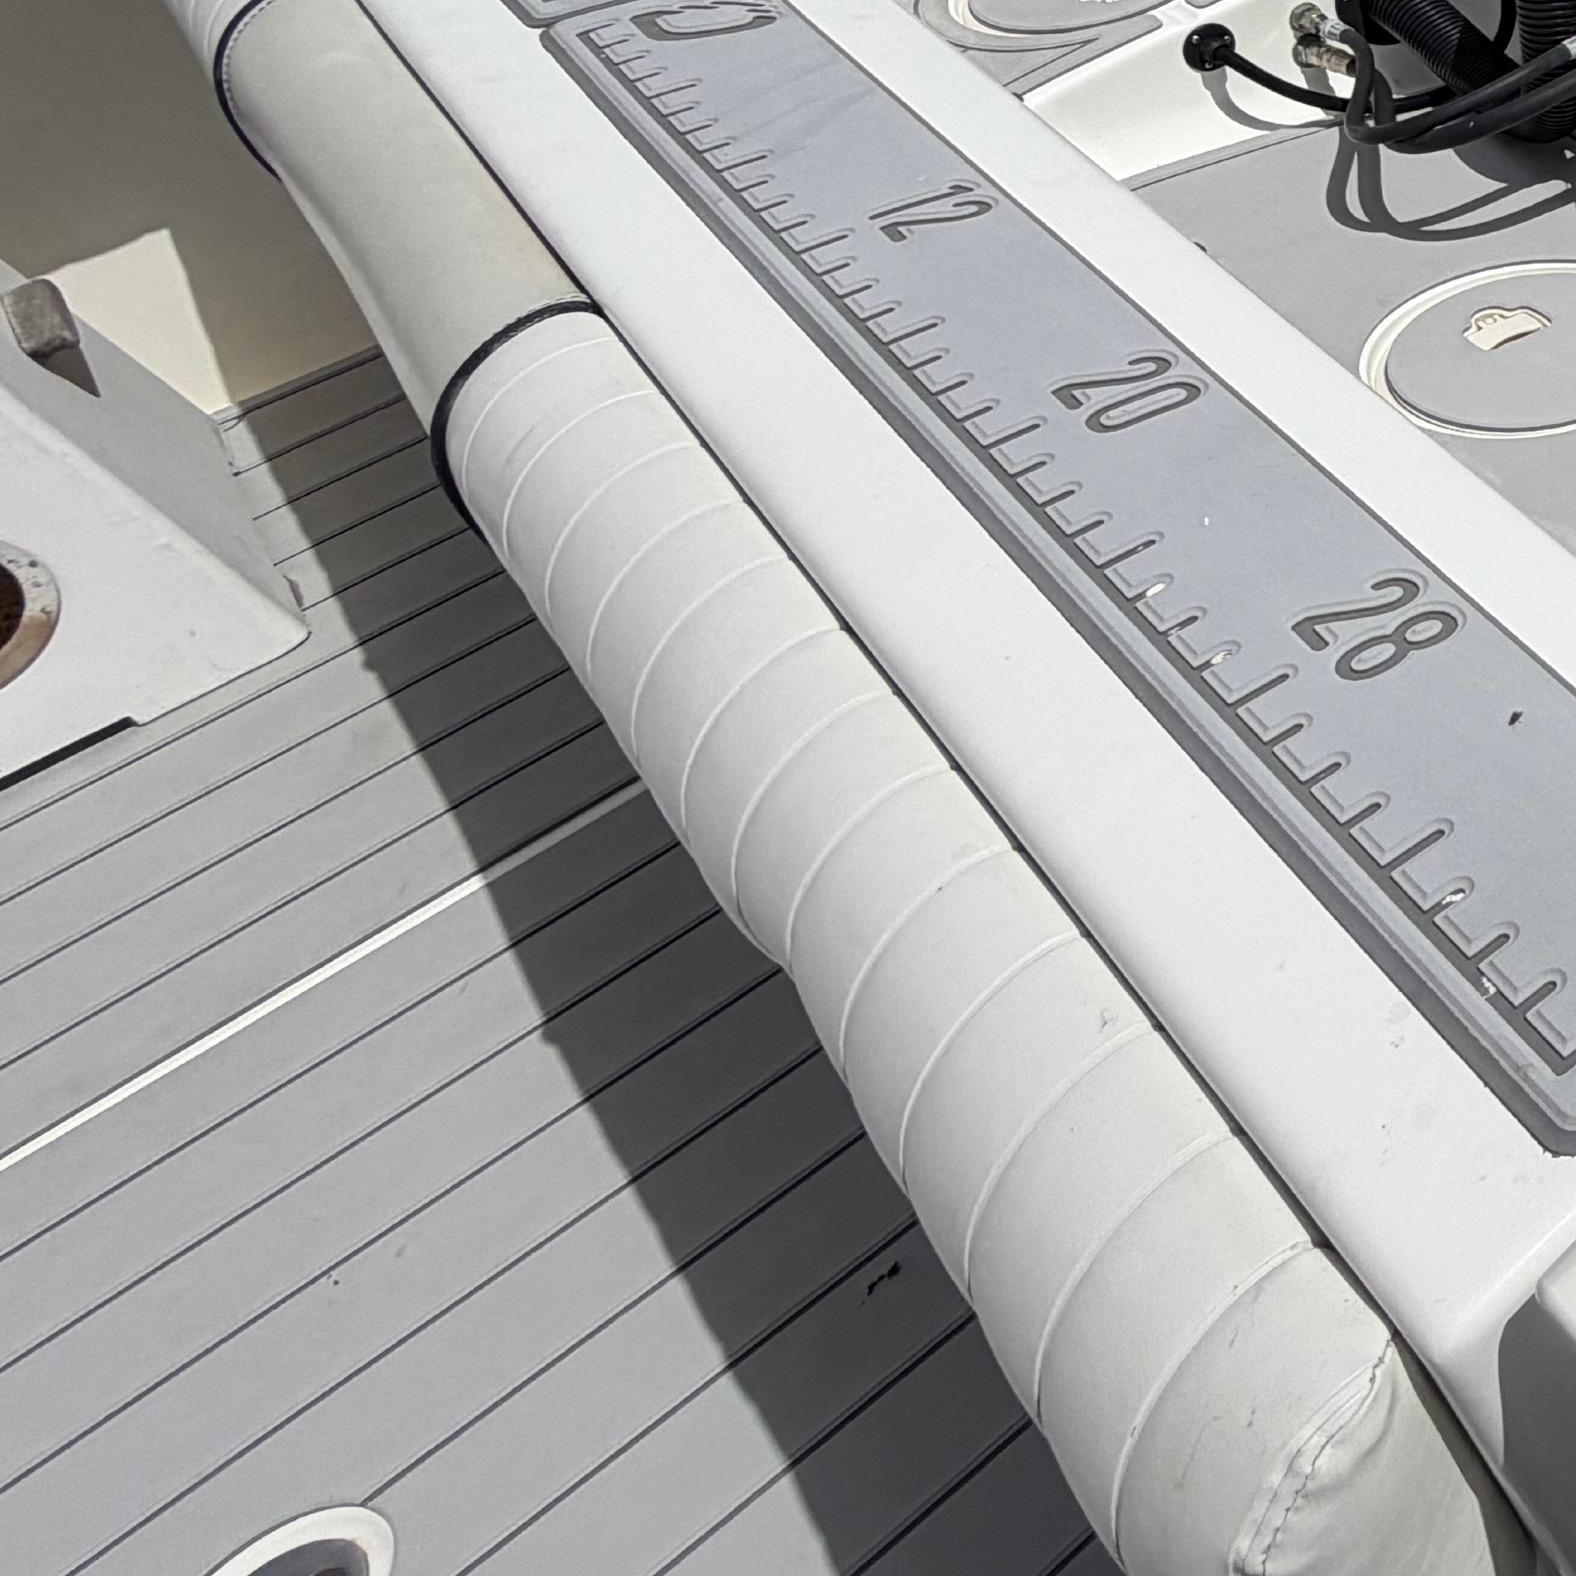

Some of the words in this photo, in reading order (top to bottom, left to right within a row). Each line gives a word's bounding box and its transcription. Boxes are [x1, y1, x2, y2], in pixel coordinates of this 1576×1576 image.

[867, 183, 993, 243] 12
[1049, 355, 1202, 434] 20
[1290, 577, 1460, 682] 28
